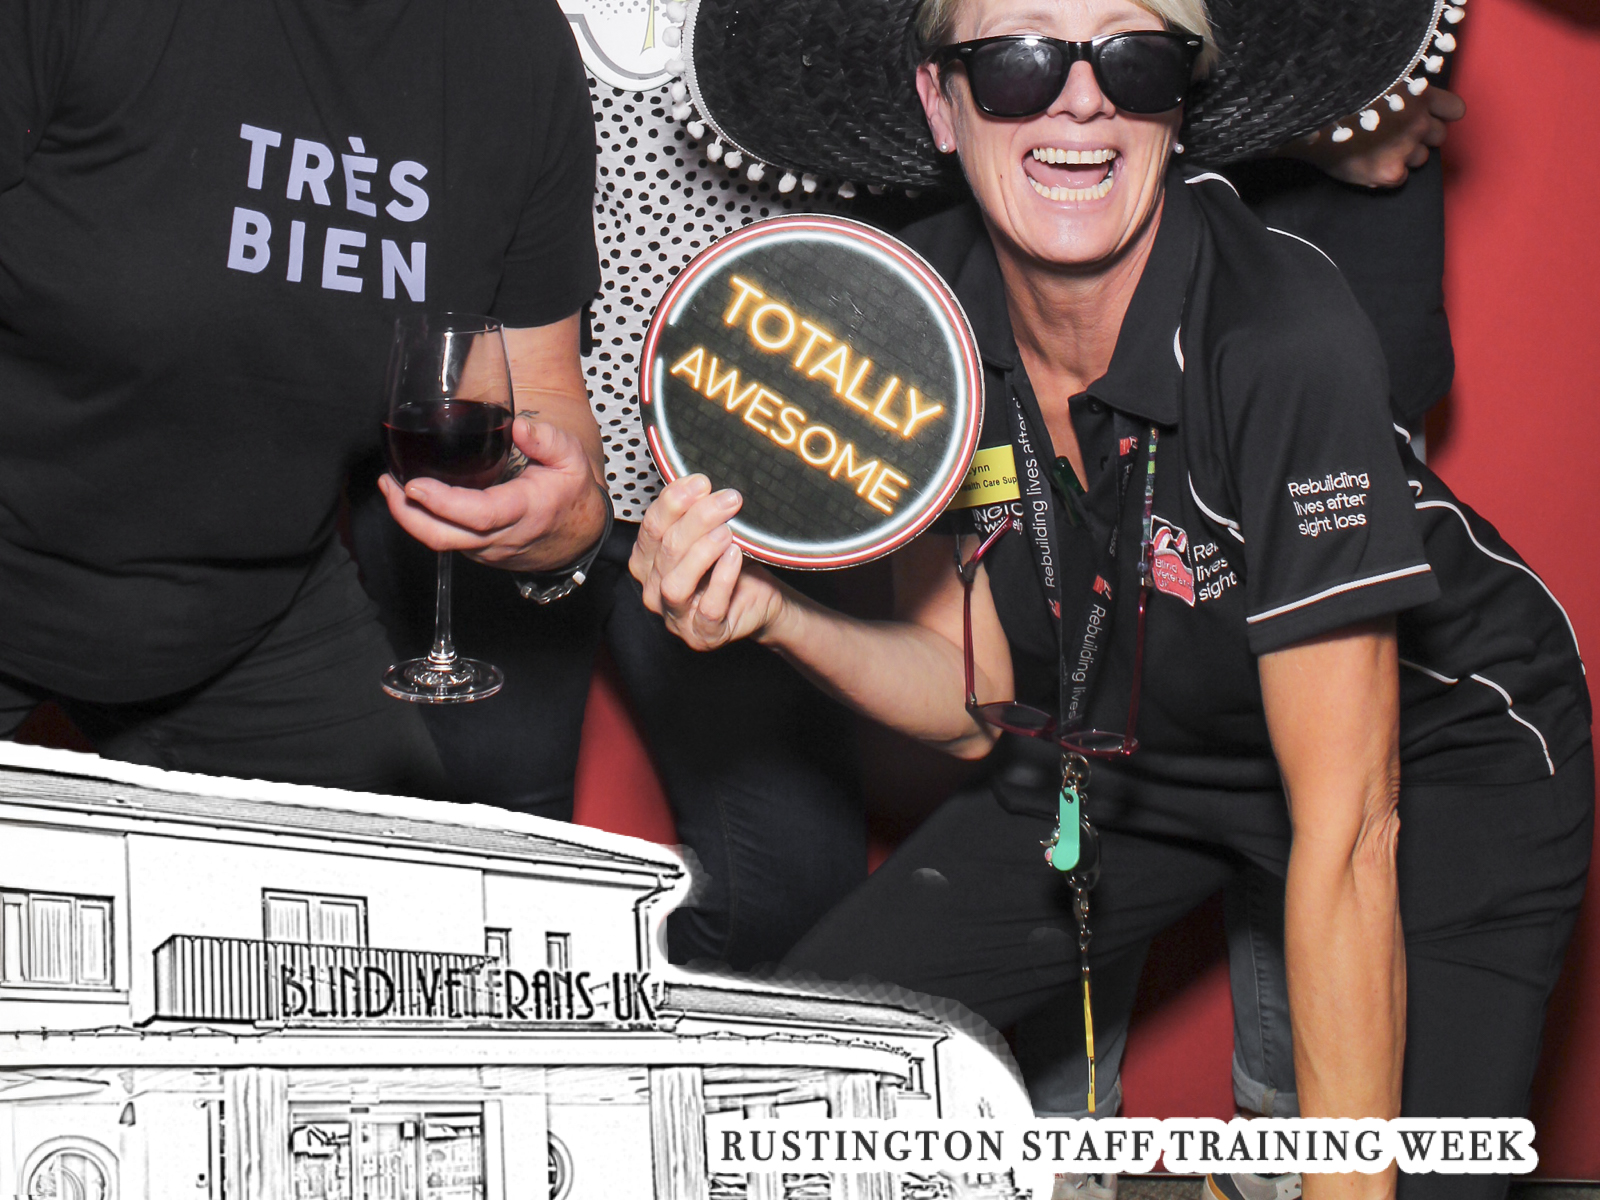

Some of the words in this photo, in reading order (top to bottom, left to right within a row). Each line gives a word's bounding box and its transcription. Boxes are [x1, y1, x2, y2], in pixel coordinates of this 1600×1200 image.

[239, 123, 430, 222] TRÈS
[227, 206, 427, 302] BIEN
[724, 276, 944, 438] TOTALLY
[671, 347, 911, 514] AWESOME
[1017, 413, 1035, 454] after
[968, 464, 991, 476] ynn
[982, 479, 1001, 488] Care
[1025, 458, 1042, 496] lives
[1287, 471, 1371, 497] Rebuilding
[1293, 500, 1325, 516] lives
[1326, 492, 1367, 510] after
[1298, 516, 1333, 537] sight
[1333, 513, 1367, 530] loss
[1032, 500, 1056, 588] Rebuilding
[1196, 557, 1229, 582] lives
[1198, 571, 1238, 601] sight
[1071, 603, 1107, 682] Rebuilding
[1068, 686, 1087, 720] lives
